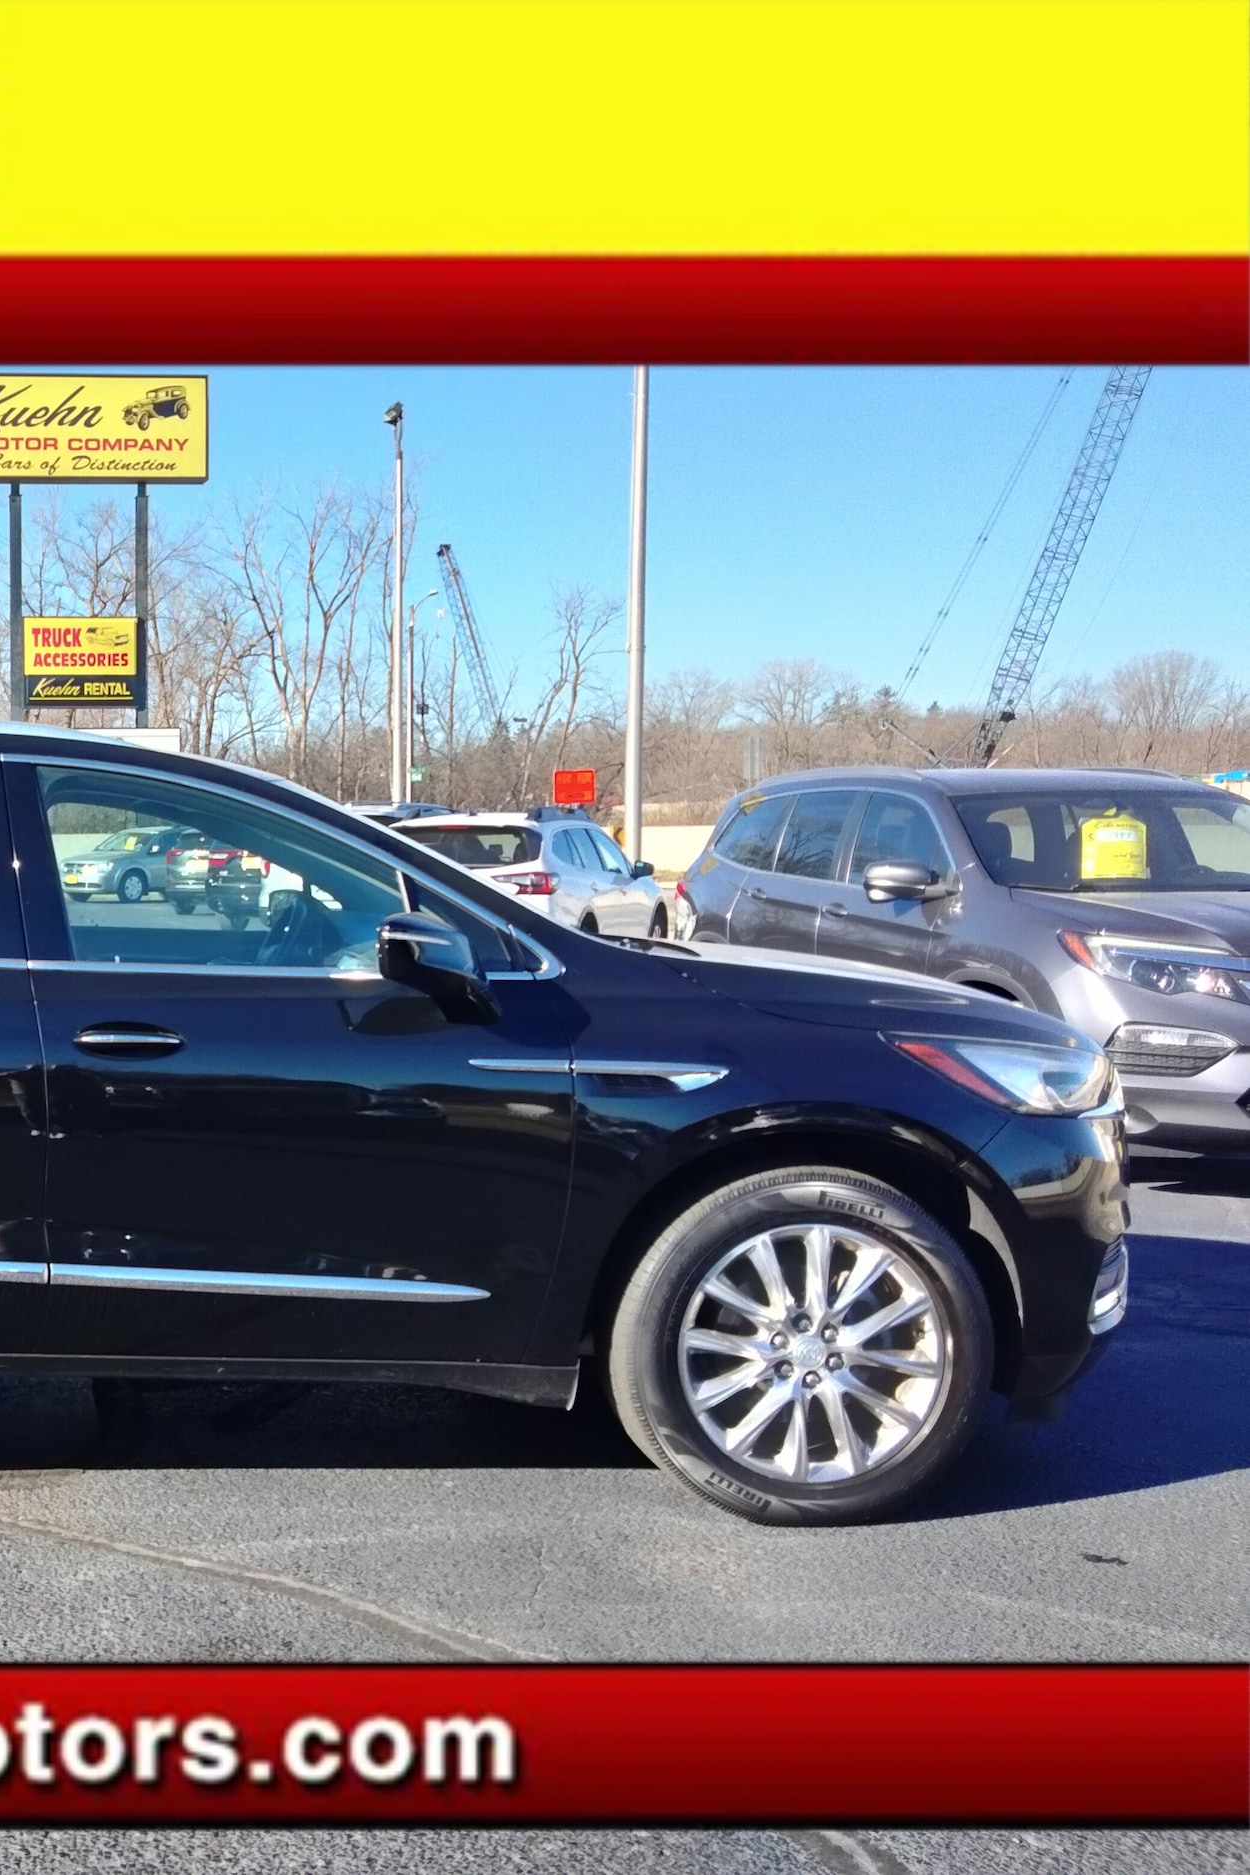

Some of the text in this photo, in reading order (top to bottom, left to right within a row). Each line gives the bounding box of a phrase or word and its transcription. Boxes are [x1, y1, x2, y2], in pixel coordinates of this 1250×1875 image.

[67, 438, 189, 452] COMPANY
[40, 457, 61, 475] of
[71, 455, 178, 471] Distinction
[31, 627, 83, 648] TRUCK
[33, 653, 130, 667] ACCESSORIES
[32, 678, 131, 698] Kuehn RENTAL
[817, 1190, 886, 1219] PIRELLI
[703, 1471, 772, 1514] PIRELLI
